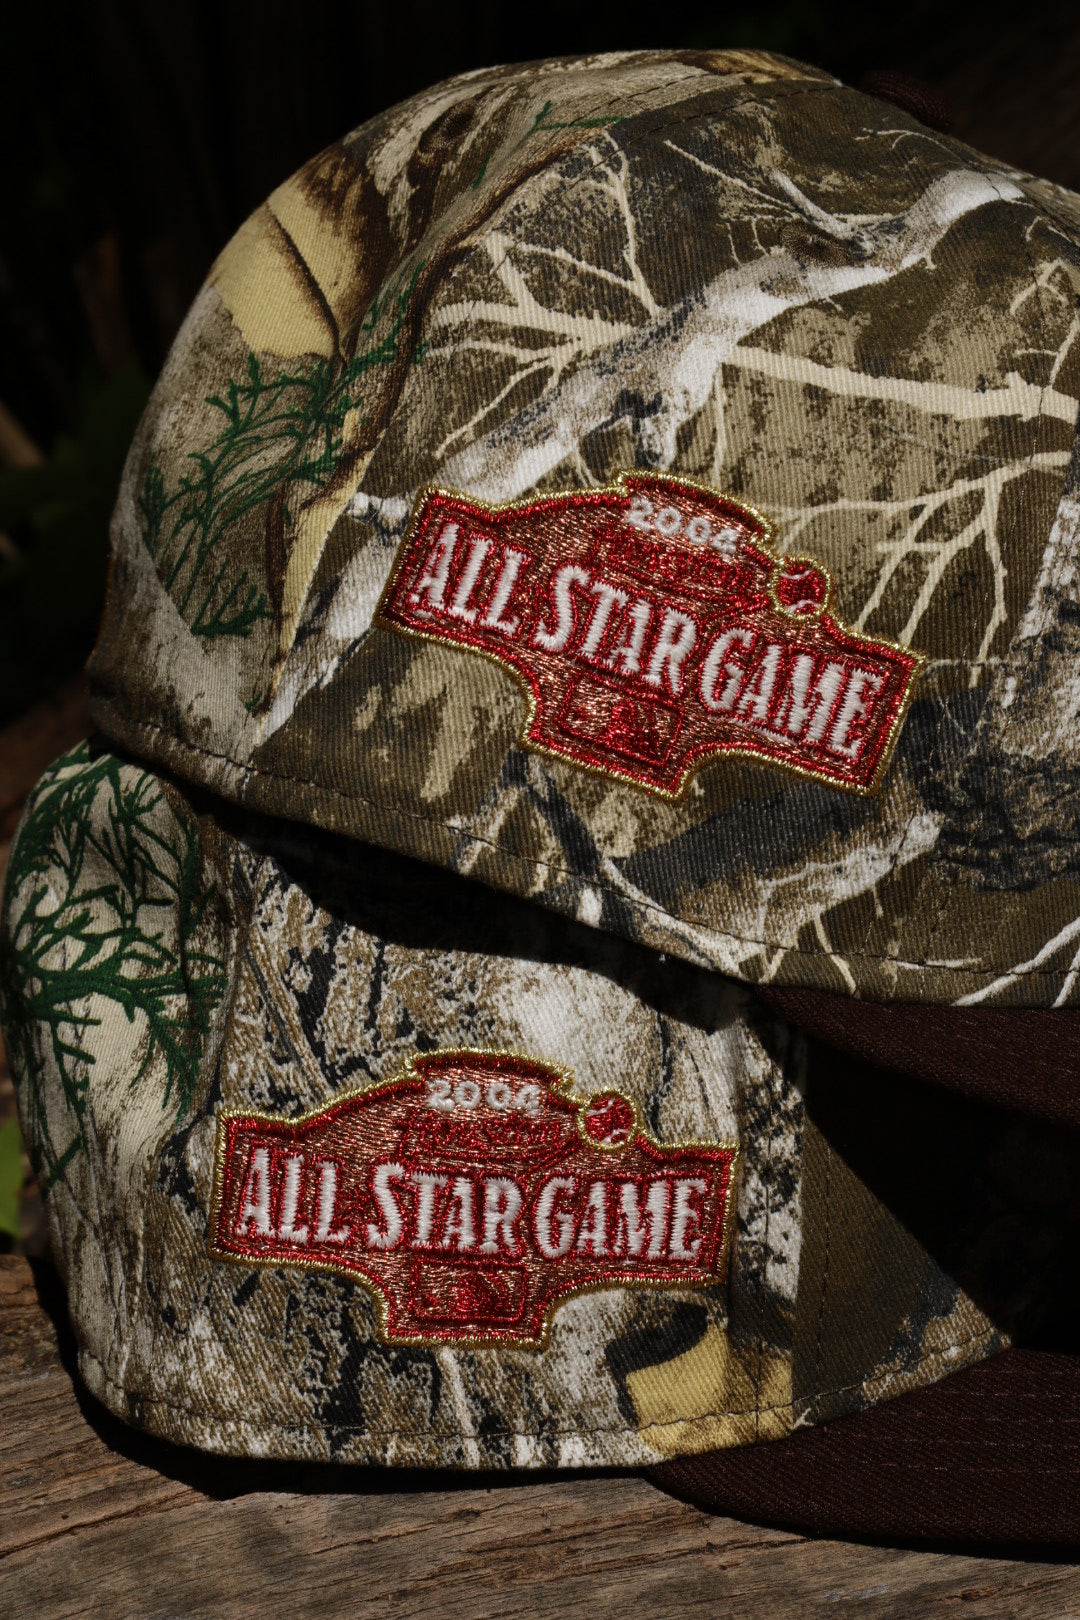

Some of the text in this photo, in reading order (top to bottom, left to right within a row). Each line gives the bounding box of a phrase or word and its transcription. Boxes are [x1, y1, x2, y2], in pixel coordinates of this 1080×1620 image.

[409, 522, 523, 635] ALL
[534, 565, 696, 695] STAR
[701, 628, 882, 757] GAME
[238, 1148, 706, 1258] ALL STAR GAME
